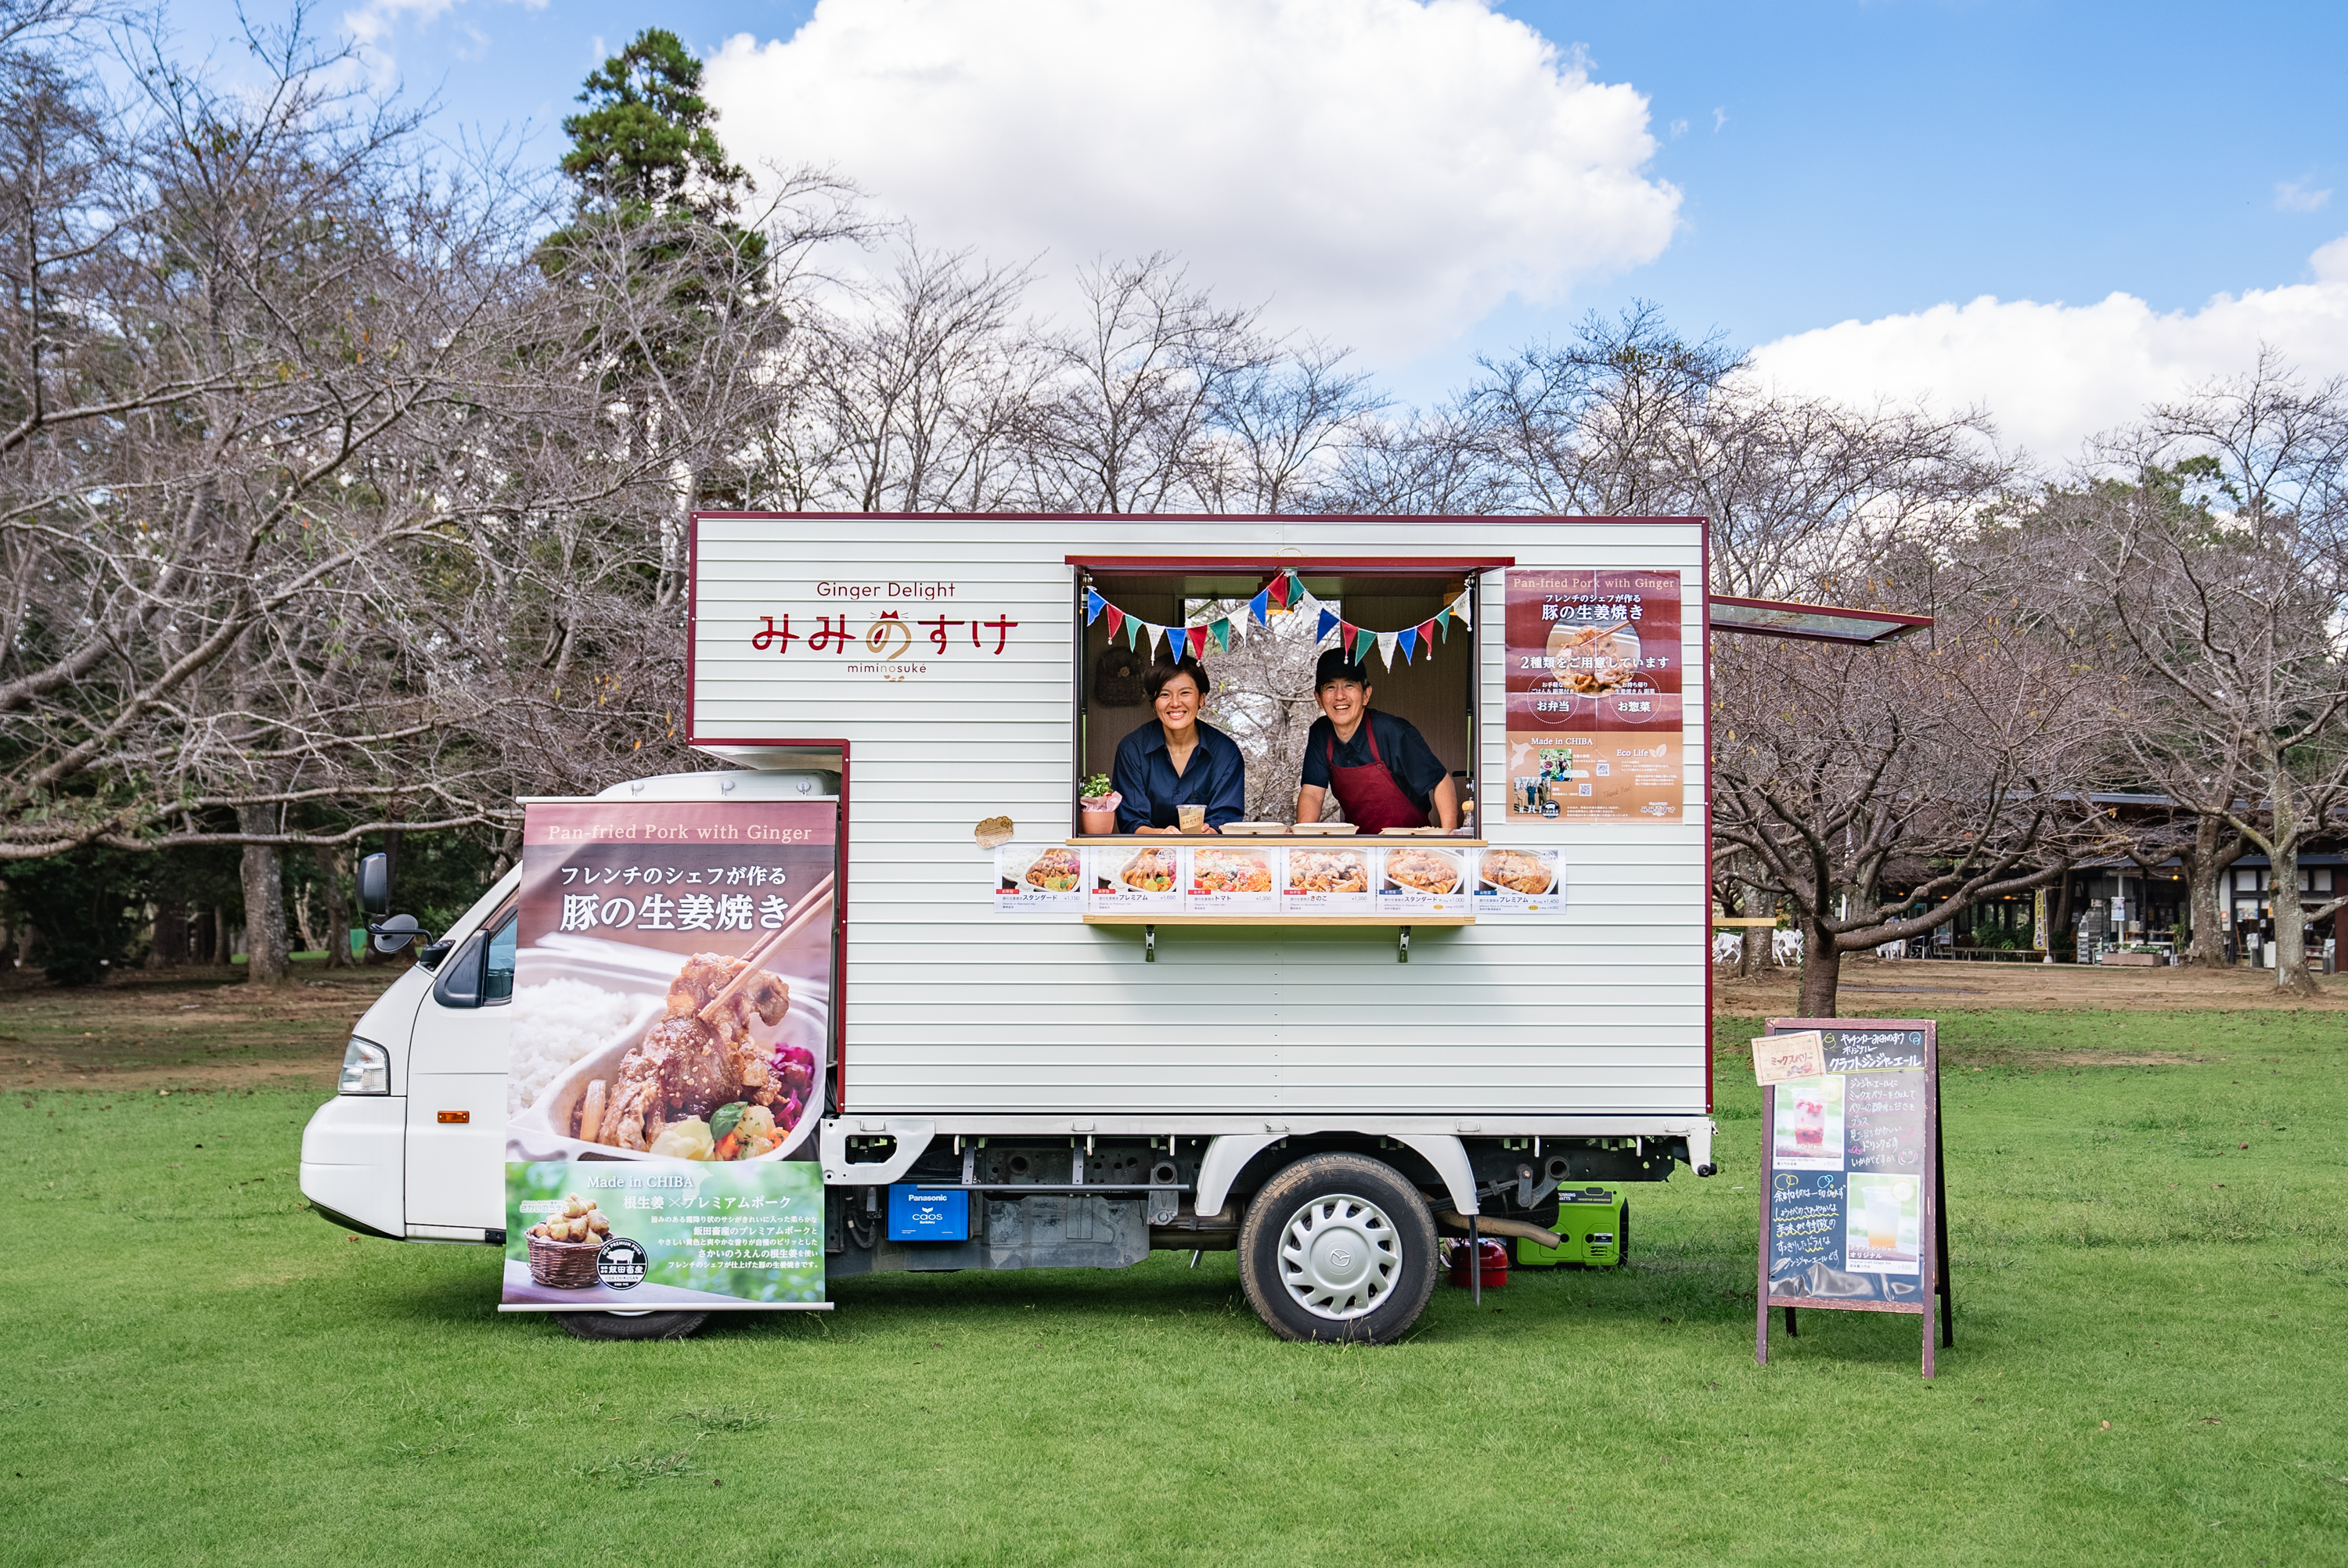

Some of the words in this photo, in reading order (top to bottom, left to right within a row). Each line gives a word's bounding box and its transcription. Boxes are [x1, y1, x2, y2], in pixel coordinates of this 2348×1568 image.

[816, 581, 880, 600] Ginger
[888, 582, 956, 600] Delight
[1513, 578, 1568, 588] Pan-fried
[1572, 578, 1600, 588] Pork
[1604, 578, 1630, 588] with
[1634, 578, 1675, 590] Ginger
[1545, 594, 1641, 603] フレンチのシェフが作る
[1541, 603, 1644, 621] 豚の生姜焼き
[751, 613, 1018, 661] みみのすけ
[848, 663, 927, 674] miminosuké
[1520, 656, 1669, 669] 2種類をご用意しています
[1536, 700, 1570, 713] お弁当
[1618, 701, 1651, 713] お惣菜
[548, 824, 636, 840] Pan-fried
[644, 824, 689, 839] Pork
[697, 824, 739, 839] with
[747, 825, 812, 843] Ginger
[561, 865, 787, 886] フレンチのシェフが作る
[560, 893, 789, 931] 豚の生姜焼き
[1842, 1045, 1878, 1056] オリジナル
[1770, 1052, 1813, 1066] ミックスベリー
[1829, 1052, 1921, 1071] クラフトジンジャーエール
[1849, 1077, 1898, 1089] ジンジャーエールに
[1850, 1115, 1869, 1126] プラス
[1863, 1137, 1898, 1153] ドリンクです
[1851, 1154, 1896, 1167] いかがですか
[586, 1176, 625, 1188] Made
[628, 1176, 642, 1188] in
[646, 1176, 694, 1188] CHIBA
[693, 1226, 818, 1235] 飯田畜産のプレミアムポークと
[698, 1249, 818, 1258] さかいのうえんの根生姜を使い
